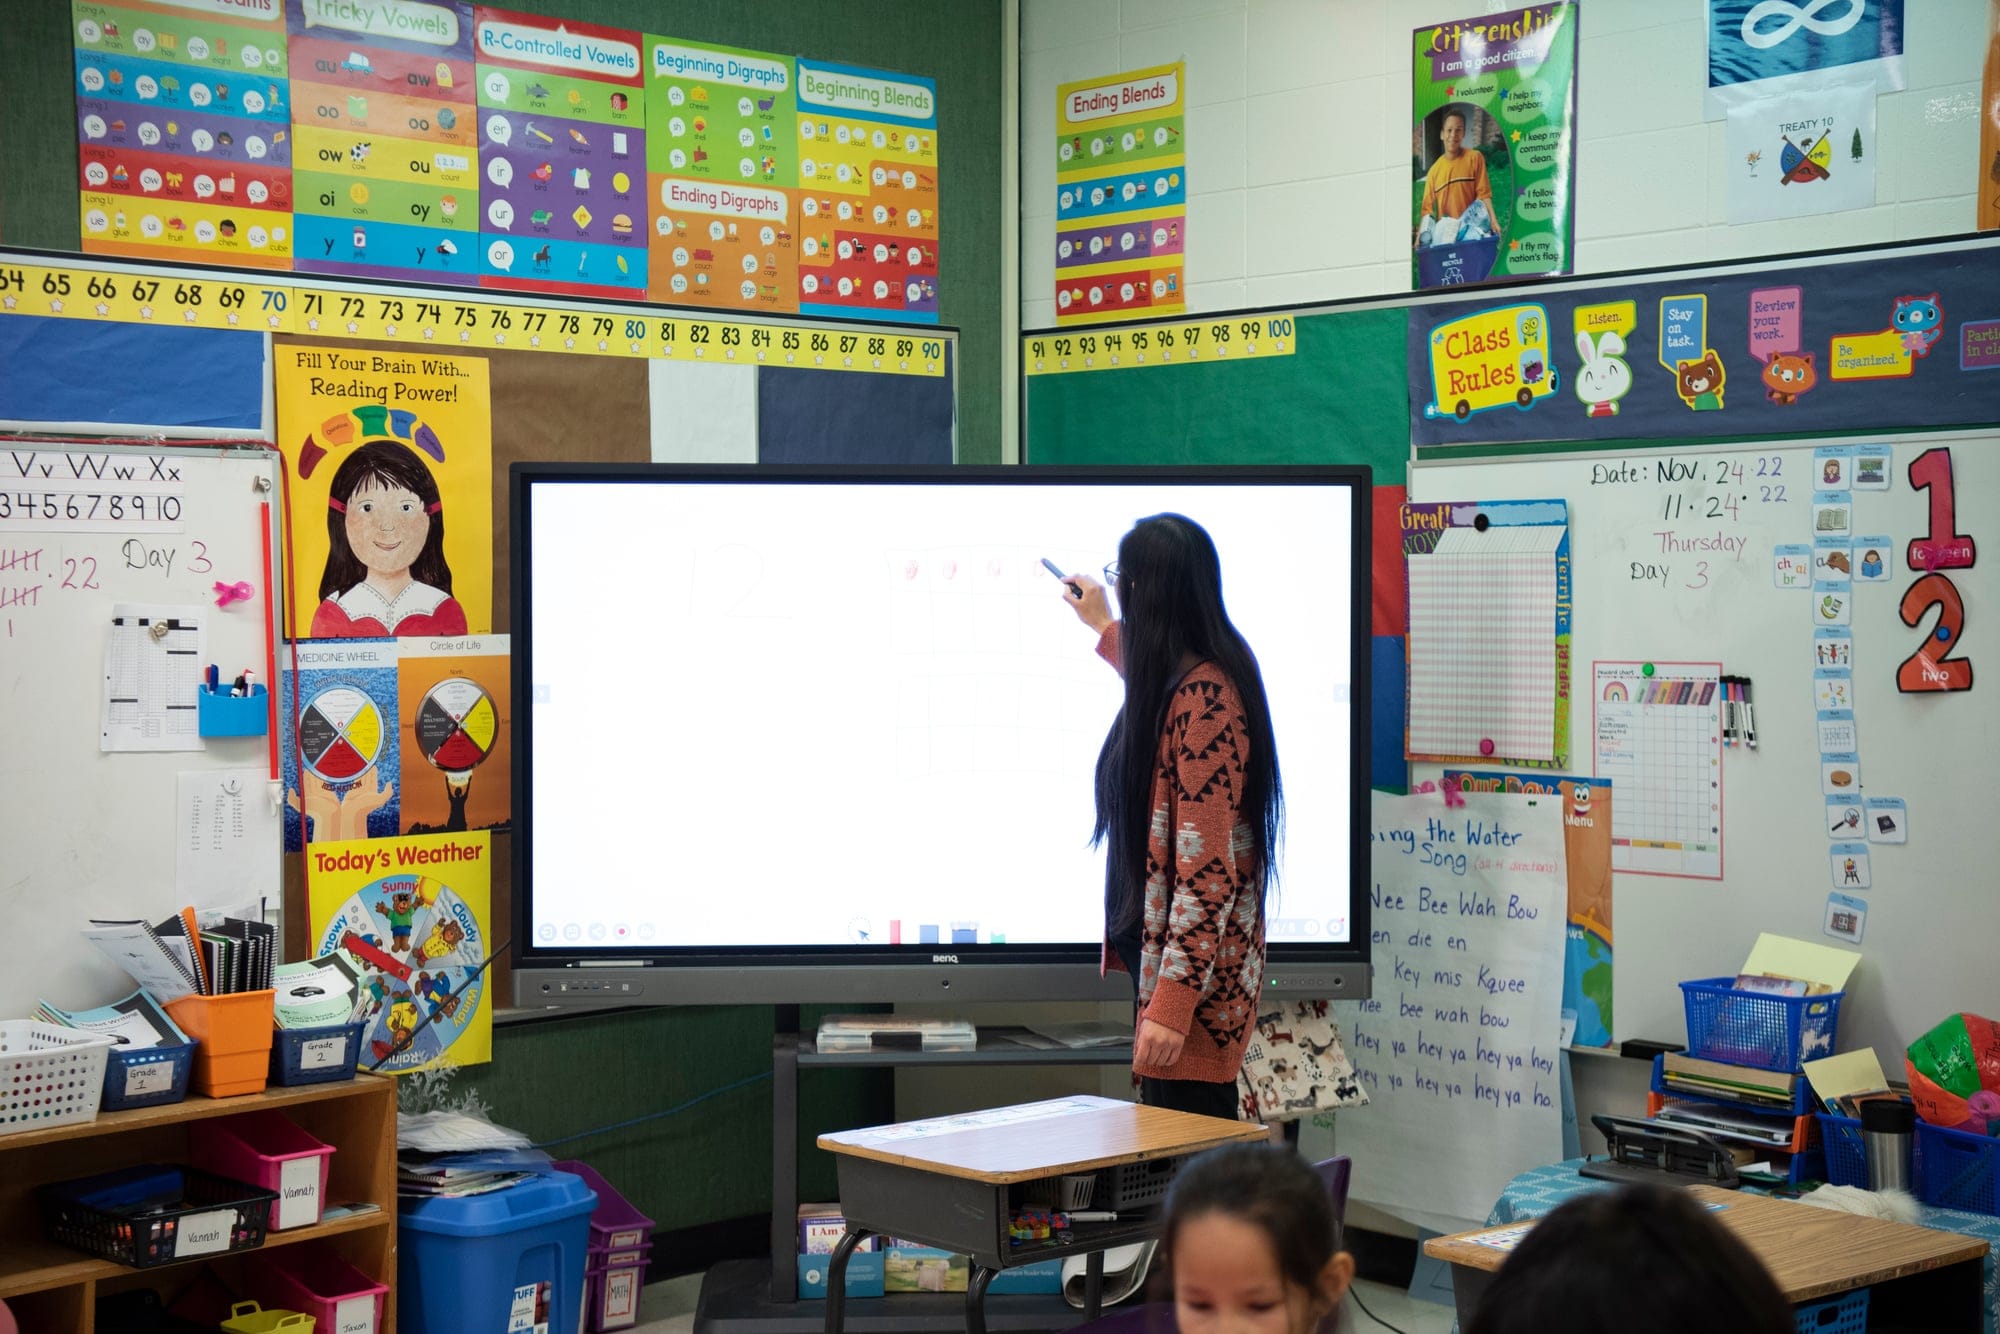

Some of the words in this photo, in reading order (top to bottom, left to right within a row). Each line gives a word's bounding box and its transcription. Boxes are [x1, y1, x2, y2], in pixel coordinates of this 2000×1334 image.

[314, 0, 373, 29] Tricky
[382, 5, 448, 36] Vowels
[484, 30, 582, 60] R-Controlled
[587, 46, 635, 69] Vowels
[315, 59, 336, 73] au
[658, 50, 724, 79] Beginning
[728, 61, 785, 85] Digraphs
[1441, 62, 1445, 72] I
[1446, 61, 1462, 71] am
[1465, 59, 1472, 67] a
[1475, 52, 1500, 69] good
[408, 73, 430, 86] aw
[491, 83, 503, 93] ar
[672, 91, 682, 100] ch
[806, 75, 880, 107] Beginning
[884, 86, 929, 109] Blends
[1073, 91, 1119, 114] Ending
[1122, 81, 1166, 105] Blends
[1513, 92, 1529, 100] help
[317, 105, 339, 118] oo
[409, 118, 429, 131] oo
[493, 125, 506, 135] er
[1779, 119, 1818, 133] TREATY
[1821, 116, 1834, 127] 10
[1528, 133, 1547, 141] keep
[319, 149, 342, 162] ow
[410, 160, 430, 173] ou
[320, 191, 335, 206] oi
[671, 185, 717, 209] Ending
[721, 191, 778, 214] Digraphs
[411, 204, 430, 221] oy
[496, 209, 508, 219] ur
[324, 238, 335, 255] y
[494, 250, 508, 260] or
[676, 252, 686, 261] ch
[745, 260, 755, 268] ge
[674, 280, 685, 288] tch
[742, 285, 755, 296] dge
[0, 268, 25, 293] 64
[132, 280, 160, 303] 67
[261, 290, 287, 312] 70
[340, 297, 365, 318] 72
[491, 309, 512, 330] 76
[625, 319, 646, 340] 80
[660, 322, 675, 342] 81
[782, 331, 800, 350] 85
[896, 339, 914, 358] 89
[921, 341, 941, 360] 90
[1755, 300, 1795, 313] Review
[1588, 312, 1622, 325] Listen.
[1668, 308, 1694, 322] Stay
[1753, 315, 1780, 328] your
[1668, 323, 1681, 333] on
[1754, 329, 1784, 340] work.
[1031, 341, 1046, 359] 91
[1131, 331, 1148, 350] 95
[1211, 324, 1230, 343] 98
[1268, 318, 1292, 338] 100
[1445, 327, 1511, 360] Class
[1667, 335, 1694, 347] task.
[1839, 345, 1853, 356] Be
[297, 353, 321, 369] Fill
[328, 354, 366, 371] Your
[372, 357, 416, 374] Brain
[422, 360, 470, 377] With...
[1837, 353, 1899, 369] organized.
[1448, 364, 1516, 396] Rules
[310, 378, 388, 404] Reading
[395, 382, 457, 402] Power!
[1591, 461, 1647, 485] Date:
[1716, 460, 1743, 485] 24
[1760, 485, 1787, 503] 22
[158, 496, 180, 521] 10
[1400, 504, 1450, 530] Great!
[1653, 531, 1747, 562] Thursday
[122, 538, 175, 578] Day
[187, 541, 212, 573] 3
[1777, 557, 1792, 571] ch
[1631, 562, 1670, 588] Day
[1686, 562, 1708, 589] 3
[1795, 562, 1808, 575] ai
[1783, 572, 1797, 585] br
[1555, 553, 1572, 626] Terrific
[430, 641, 453, 651] Circle
[456, 641, 464, 650] of
[466, 641, 481, 650] Life
[297, 653, 344, 663] MEDICINE
[346, 652, 380, 662] WHEEL
[1922, 670, 1949, 682] two
[1565, 814, 1593, 828] Menu
[1426, 818, 1455, 842] the
[1467, 819, 1522, 846] Water
[314, 848, 391, 874] Today's
[396, 842, 483, 866] Weather
[1420, 842, 1466, 876] Song
[381, 880, 419, 894] Sunny
[1419, 887, 1448, 914] Bee
[1460, 891, 1495, 917] Wah
[1507, 894, 1537, 919] Bow
[452, 902, 477, 944] Cloudy
[320, 914, 348, 957] Snowy
[1408, 930, 1432, 947] die
[1448, 937, 1467, 951] en
[1434, 970, 1462, 987] mis
[452, 988, 478, 1028] Windy
[1400, 992, 1423, 1018] bee
[1435, 1007, 1468, 1023] wah
[1480, 1005, 1509, 1028] bow
[308, 1041, 333, 1050] Grade
[1354, 1024, 1380, 1053] hey
[1391, 1040, 1406, 1058] ya
[1418, 1030, 1443, 1060] hey
[1450, 1047, 1467, 1064] ya
[316, 1052, 326, 1062] 2
[130, 1068, 157, 1080] Grade
[1416, 1067, 1439, 1096] hey
[283, 1183, 315, 1200] Vannah
[188, 1230, 220, 1243] Vannah
[819, 1227, 838, 1236] Am
[610, 1284, 628, 1299] MATH
